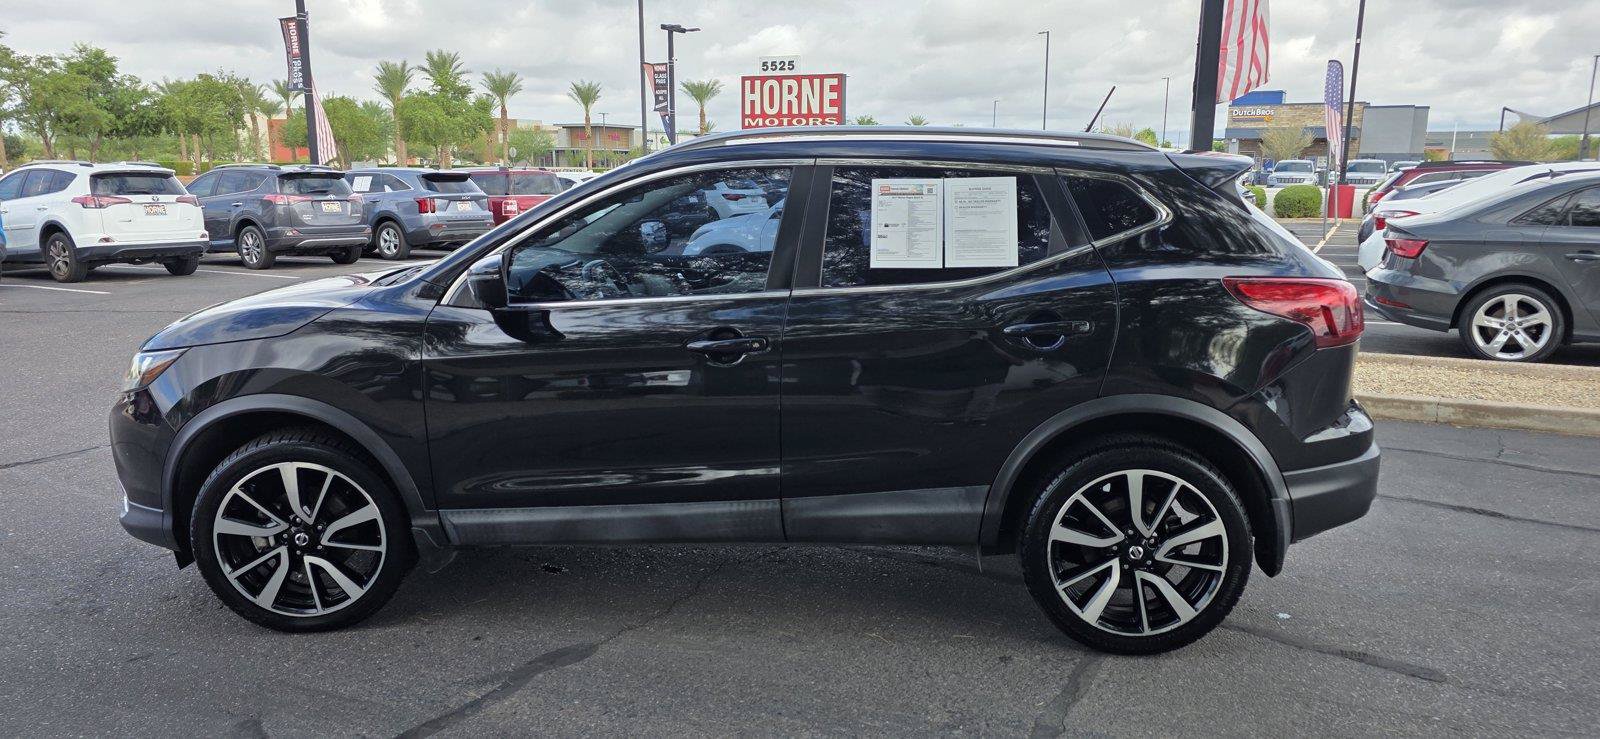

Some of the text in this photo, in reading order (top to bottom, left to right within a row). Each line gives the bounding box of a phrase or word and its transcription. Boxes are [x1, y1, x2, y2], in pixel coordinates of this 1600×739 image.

[288, 22, 301, 55] HORNE
[762, 60, 795, 72] 5525
[744, 78, 838, 115] HORNE
[744, 117, 838, 127] MOTORS
